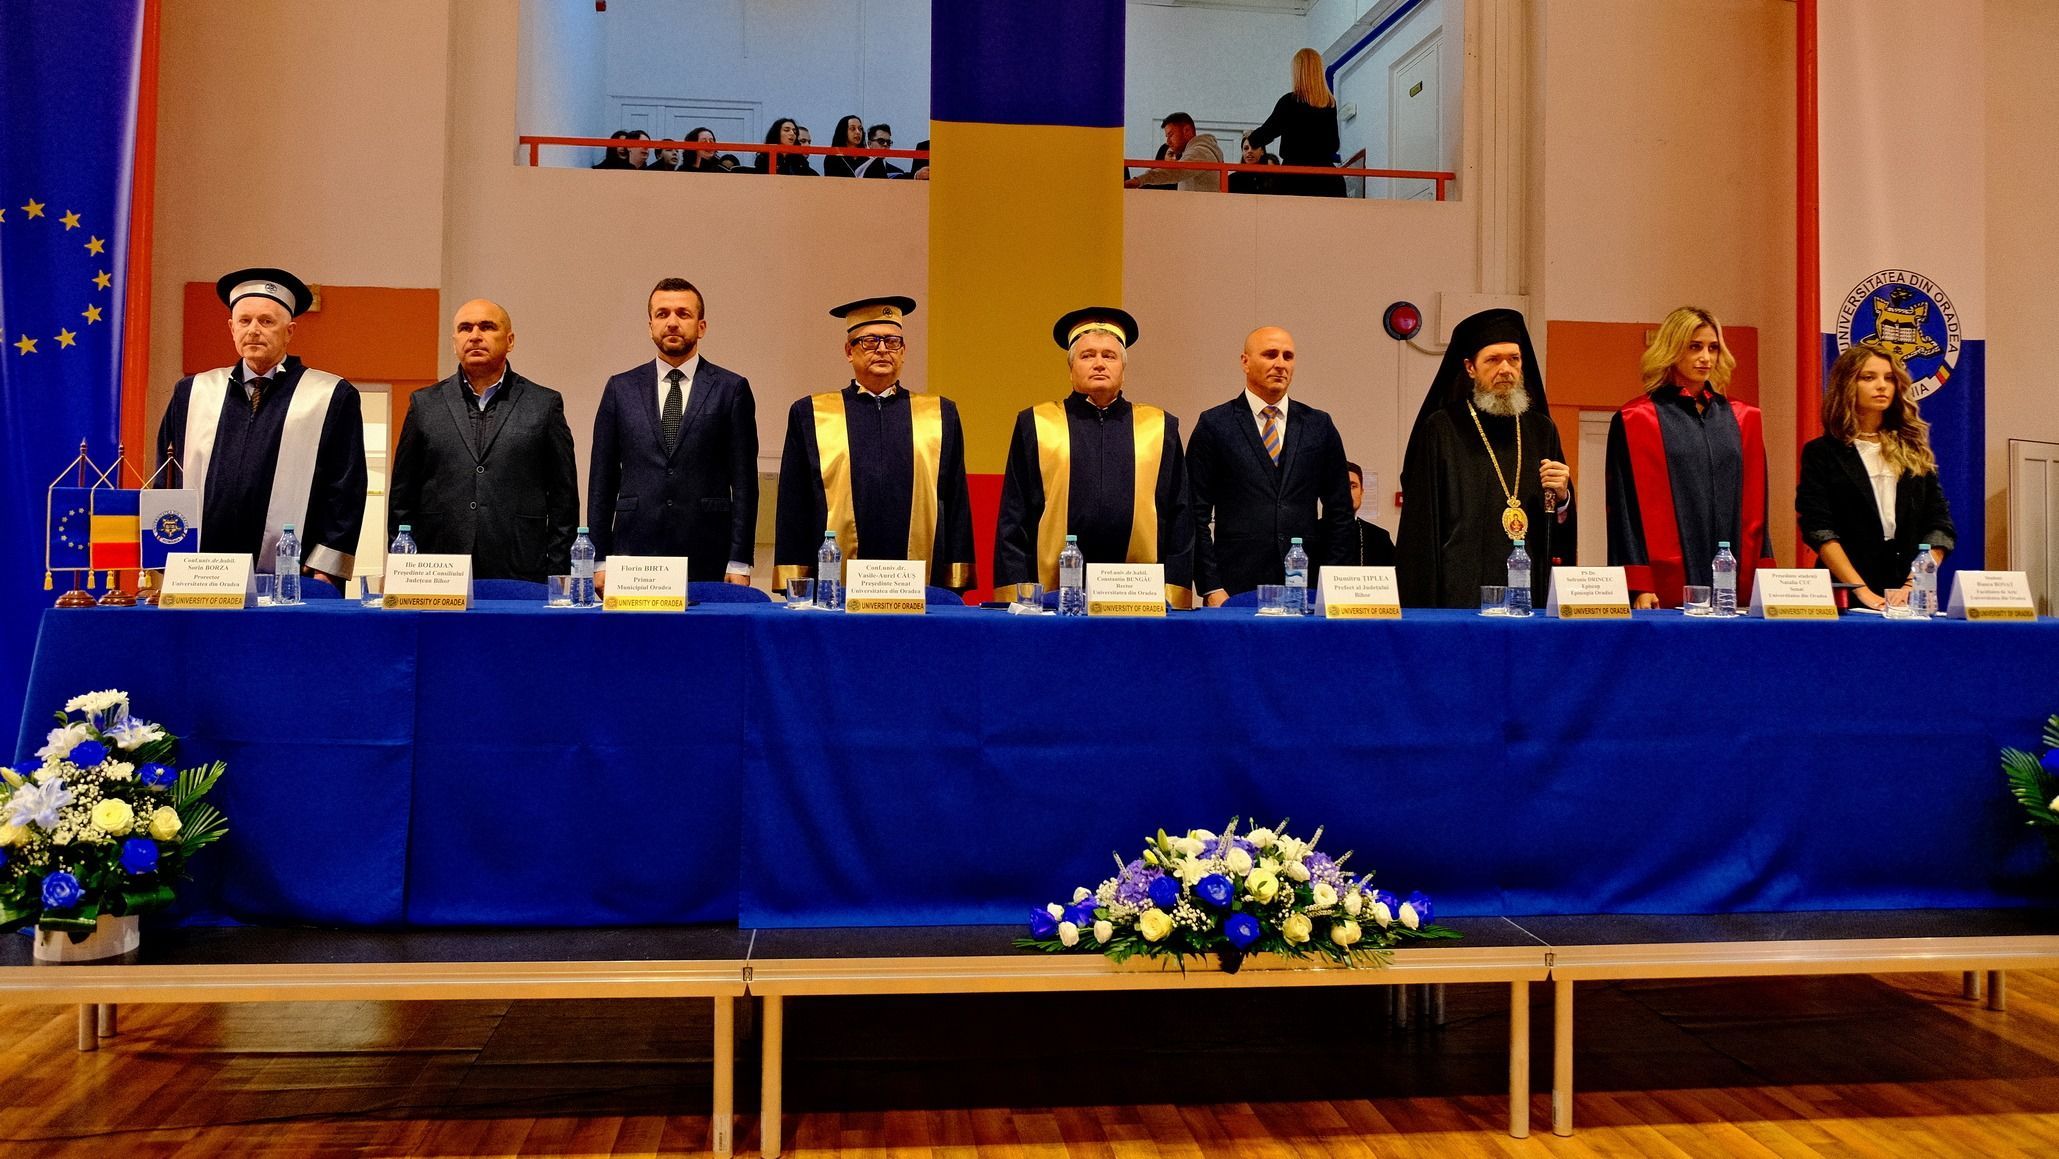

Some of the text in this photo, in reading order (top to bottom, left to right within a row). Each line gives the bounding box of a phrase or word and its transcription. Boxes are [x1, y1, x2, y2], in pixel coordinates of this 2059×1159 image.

[1838, 271, 1960, 353] UNIVERSITATEA DIN ORADEA
[442, 598, 465, 606] ORADEA
